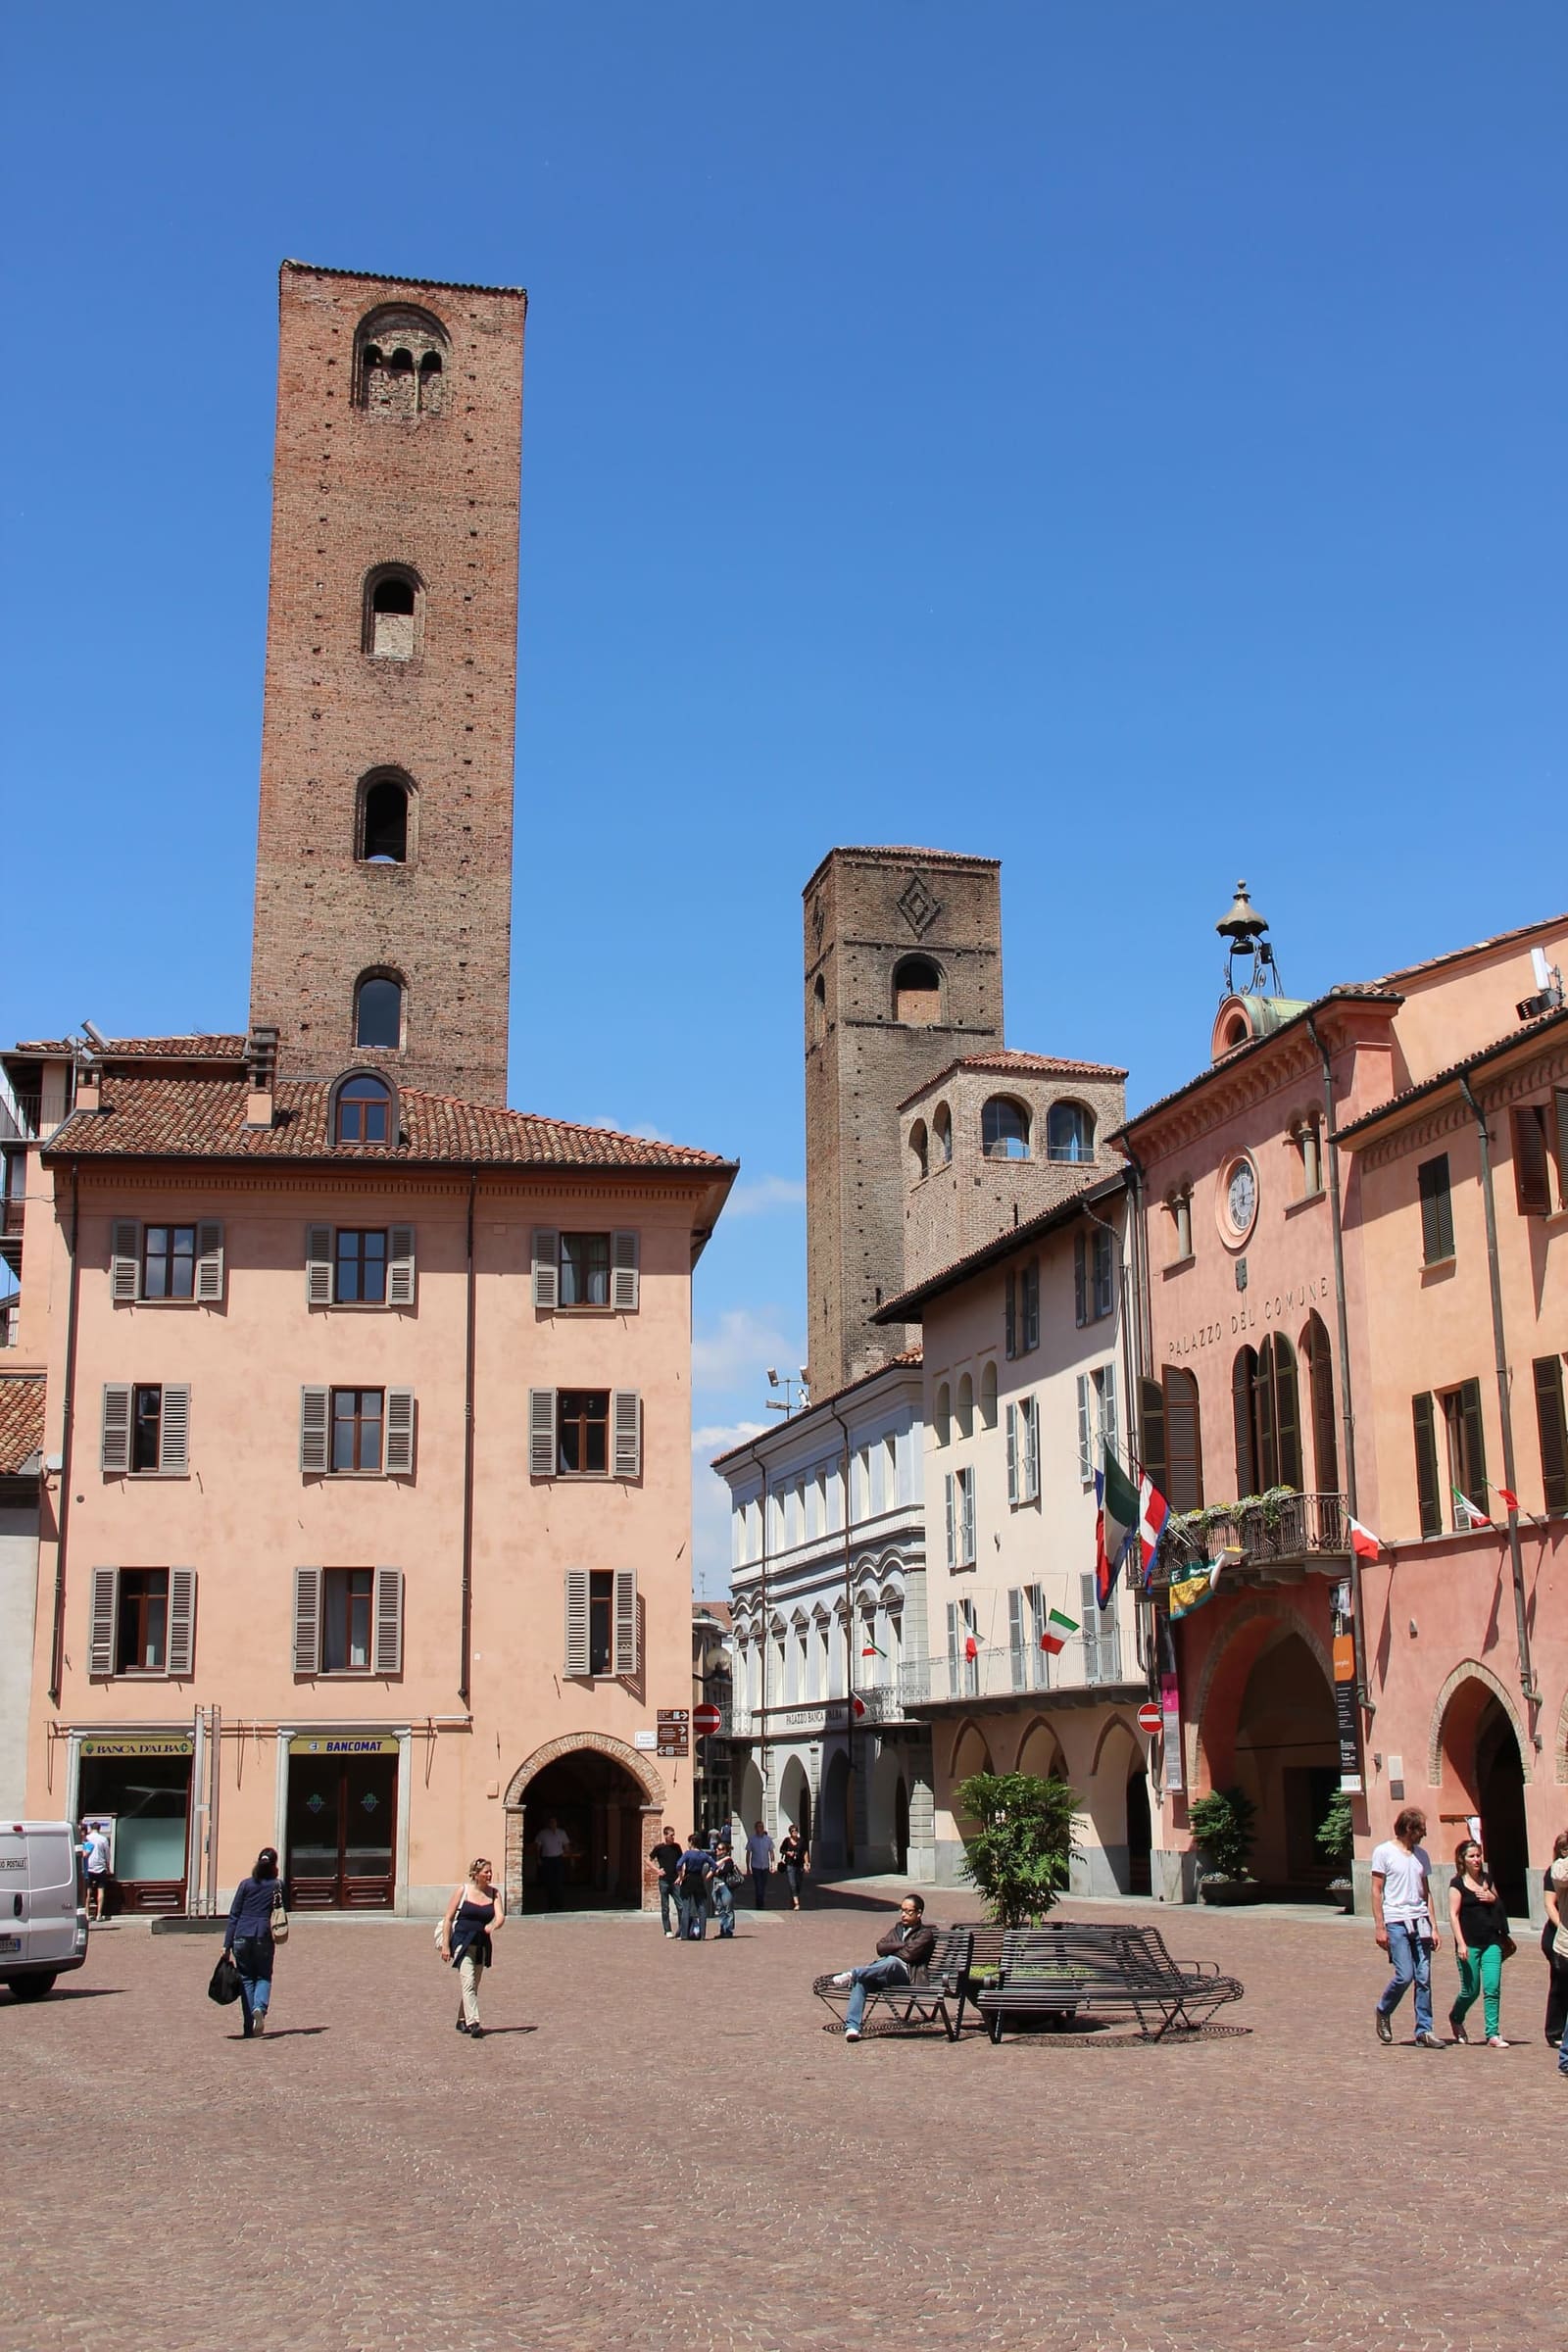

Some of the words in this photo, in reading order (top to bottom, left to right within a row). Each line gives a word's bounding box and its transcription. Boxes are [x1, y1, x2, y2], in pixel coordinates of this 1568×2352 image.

[1169, 1323, 1222, 1360] PALAZZO
[1231, 1309, 1255, 1334] DEL
[1264, 1277, 1328, 1320] COMUNE
[786, 1713, 807, 1725] PALAZZO
[808, 1710, 824, 1723] BANCA
[97, 1744, 136, 1753] BANCA
[139, 1743, 179, 1753] D'ALBA
[326, 1740, 383, 1752] BANCOMAT
